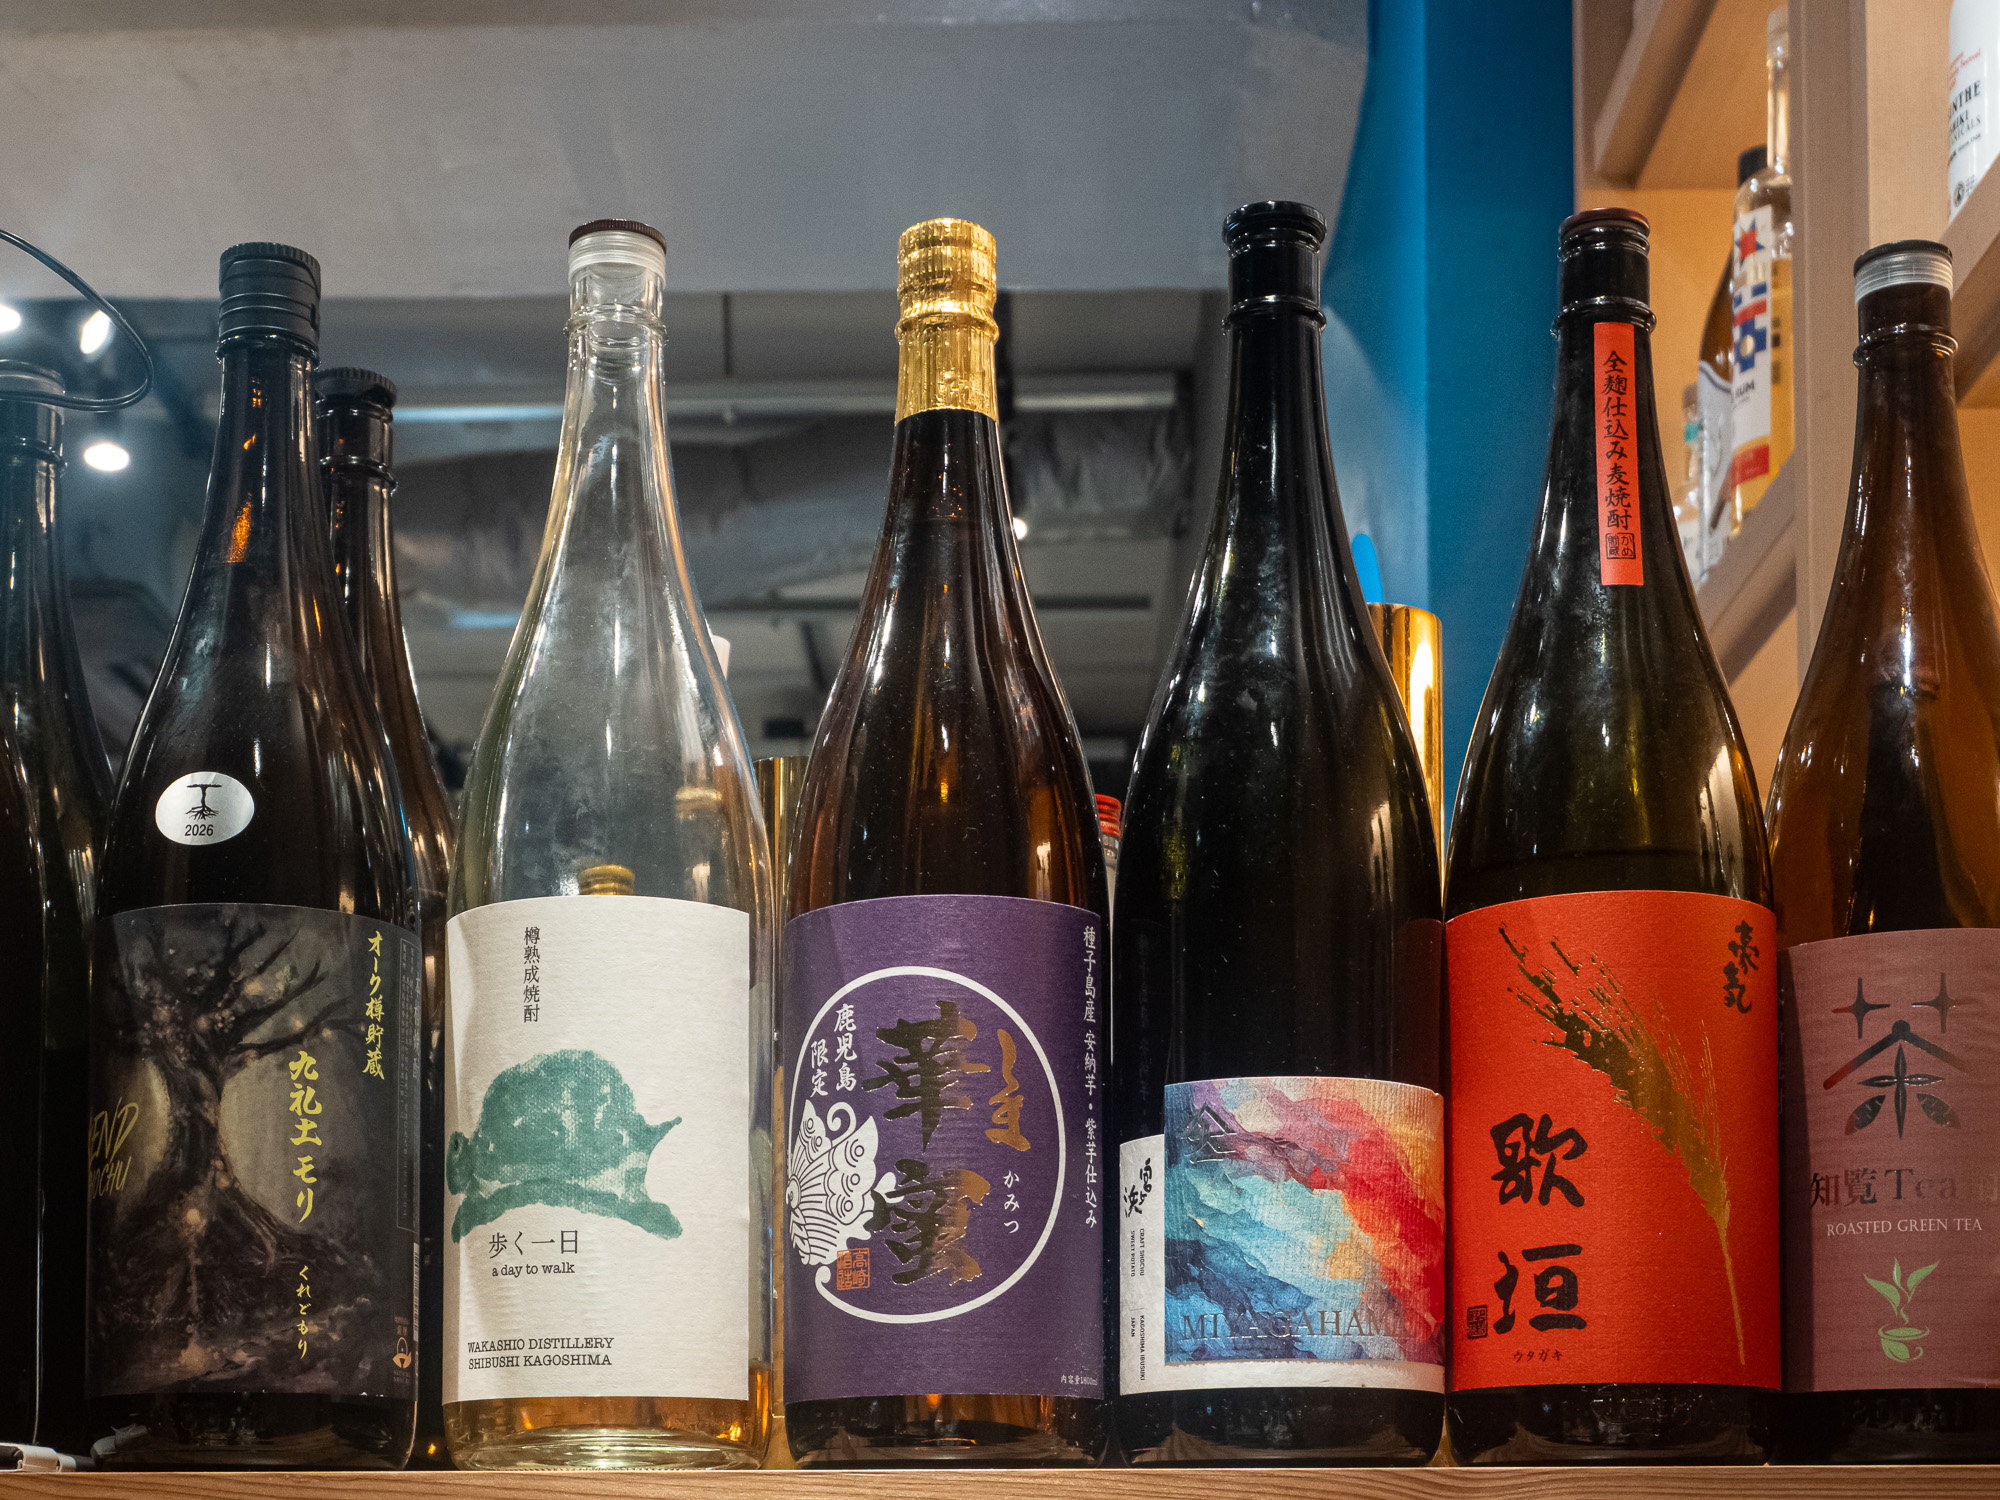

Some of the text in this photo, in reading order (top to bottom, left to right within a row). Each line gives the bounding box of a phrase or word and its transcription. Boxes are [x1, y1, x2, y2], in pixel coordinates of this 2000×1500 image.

[1602, 350, 1632, 531] 全麹仕込み麦焼酎
[185, 824, 214, 836] 2026
[523, 926, 540, 1023] 樽熟成焼酎
[1083, 925, 1097, 1022] 種子島産
[362, 930, 385, 1080] オーク樽貯蔵
[810, 1040, 829, 1098] 限定
[834, 1003, 857, 1093] 鹿児島
[1003, 1169, 1020, 1234] かみつ
[1490, 1113, 1588, 1335] 歌垣
[1827, 1218, 1983, 1237] ROASTED GREEN TEA
[488, 1229, 578, 1259] 歩く一日
[491, 1261, 576, 1279] a day to walk
[297, 1264, 312, 1360] くれどもり
[468, 1337, 615, 1354] WAKASHIO DISTILLERY
[469, 1353, 613, 1370] SHIBUSHI KAGOSHIMA
[1513, 1348, 1563, 1363] ウタガキ
